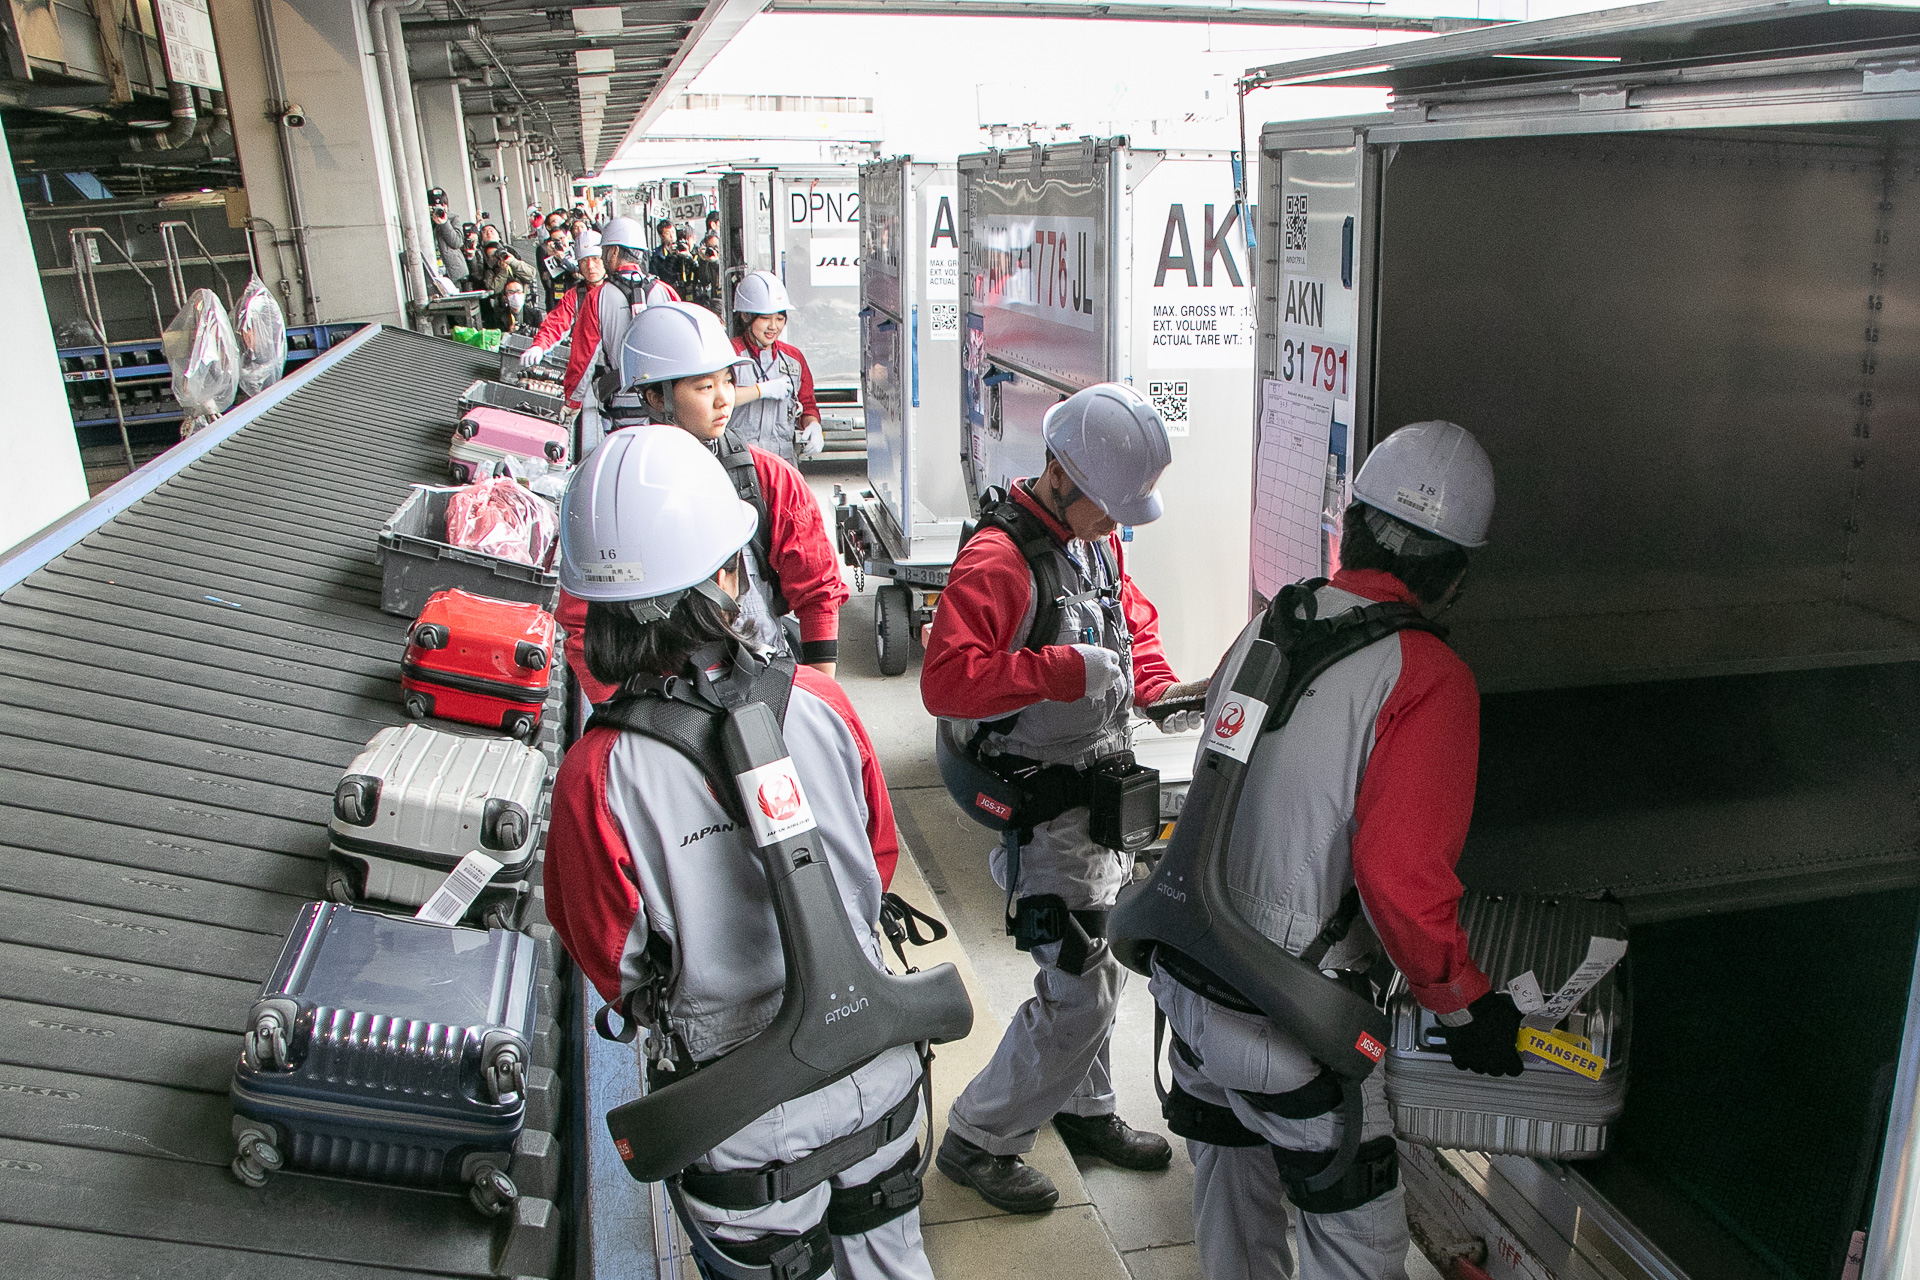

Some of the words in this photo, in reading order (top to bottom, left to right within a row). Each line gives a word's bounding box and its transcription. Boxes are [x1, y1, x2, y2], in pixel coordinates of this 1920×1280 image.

[675, 203, 703, 219] 437
[1153, 305, 1177, 317] MAX.
[1180, 305, 1217, 317] GROSS
[1219, 305, 1236, 317] WT.
[1285, 279, 1324, 329] AKN
[1153, 320, 1173, 331] EXT.
[1176, 320, 1218, 331] VOLUME
[1152, 334, 1192, 346] ACTUAL
[1195, 334, 1221, 345] TARE
[1283, 338, 1348, 395] 31791
[1418, 483, 1437, 496] 18
[599, 548, 617, 560] 16
[905, 567, 950, 585] B-309
[1217, 726, 1234, 737] JAL
[680, 822, 734, 848] JAPAN
[1529, 1035, 1598, 1073] TRANSFER
